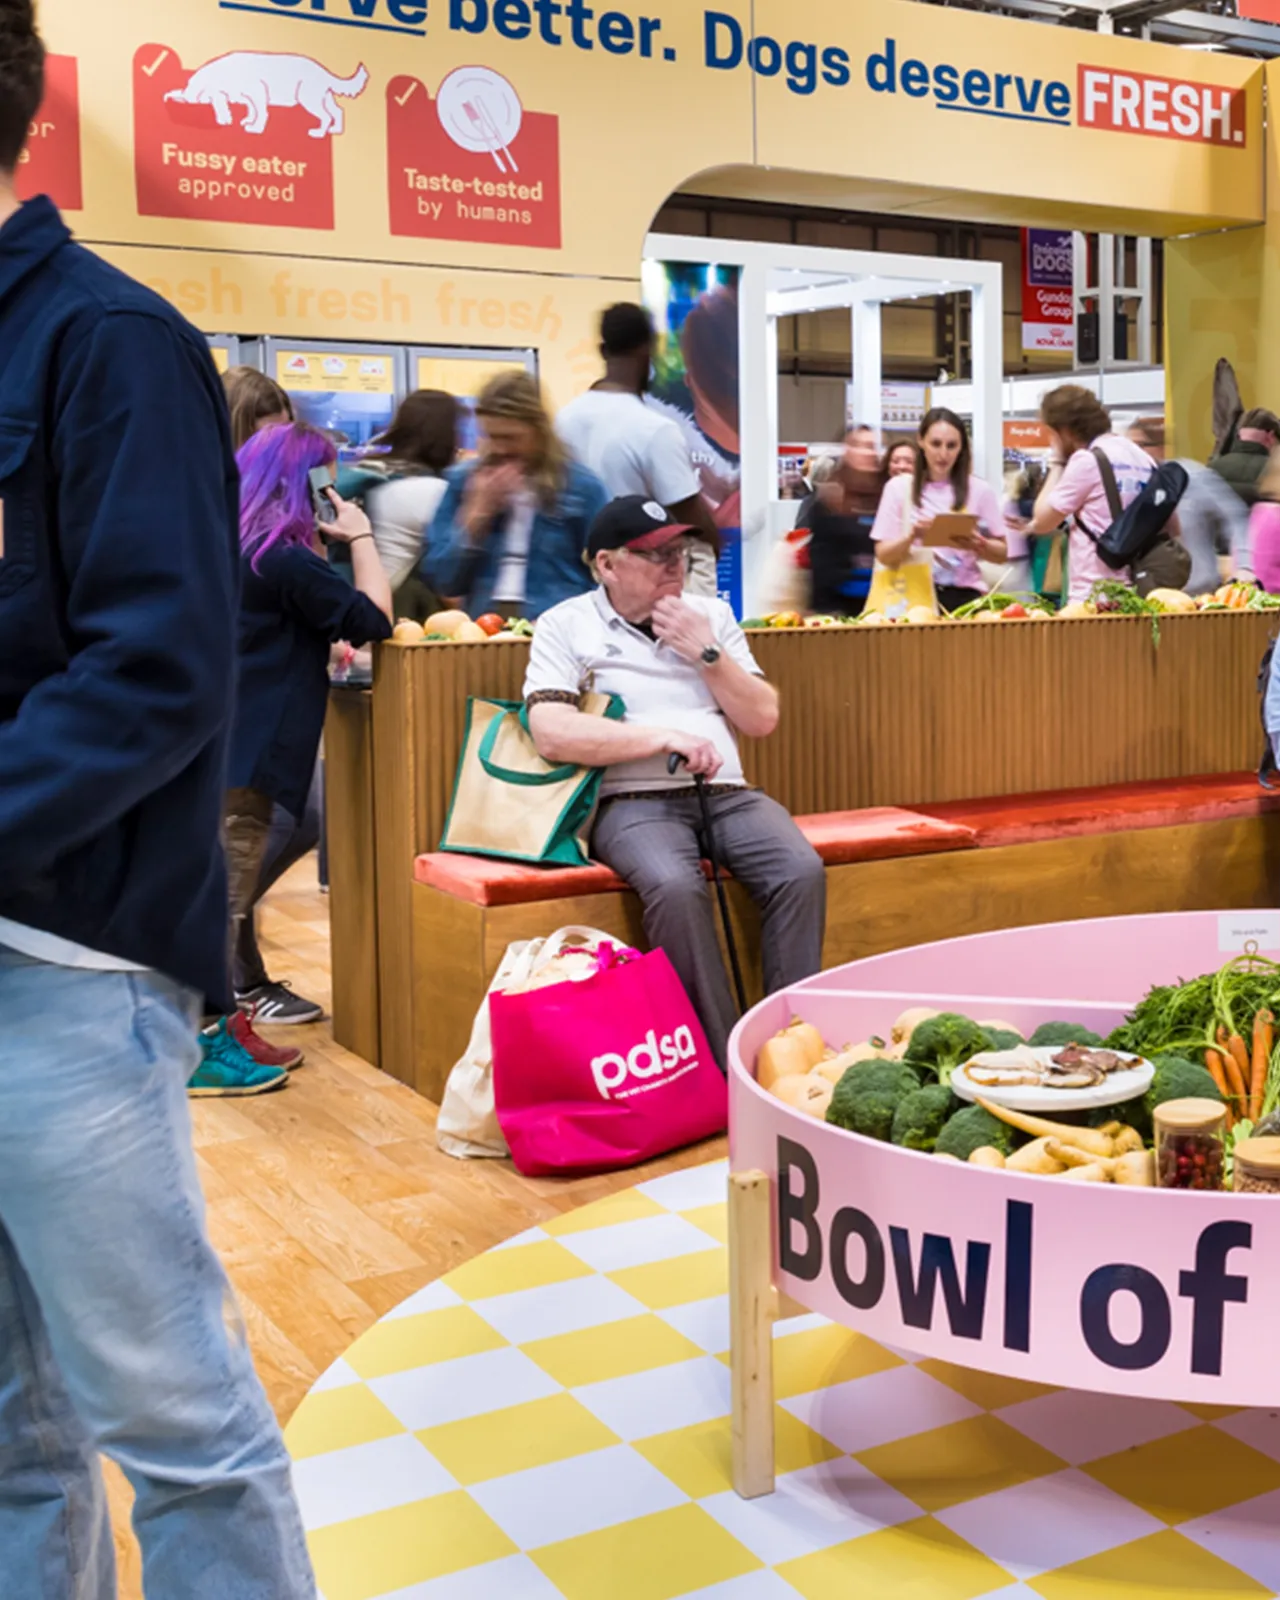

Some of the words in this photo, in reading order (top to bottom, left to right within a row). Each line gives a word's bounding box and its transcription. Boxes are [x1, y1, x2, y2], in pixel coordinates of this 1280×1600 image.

[449, 0, 677, 61] better.
[704, 11, 850, 95] Dogs
[865, 38, 1071, 118] deserve
[1082, 70, 1244, 143] FRESH.
[162, 143, 236, 175] Fussy
[242, 155, 307, 177] eater
[403, 167, 543, 202] Taste-tested
[178, 177, 295, 202] approved
[417, 198, 443, 219] by
[456, 202, 532, 225] humans
[270, 272, 412, 325] fresh
[436, 280, 563, 341] fresh
[590, 1024, 697, 1100] pdsa
[776, 1134, 1034, 1354] Bowl
[1079, 1220, 1253, 1376] of
